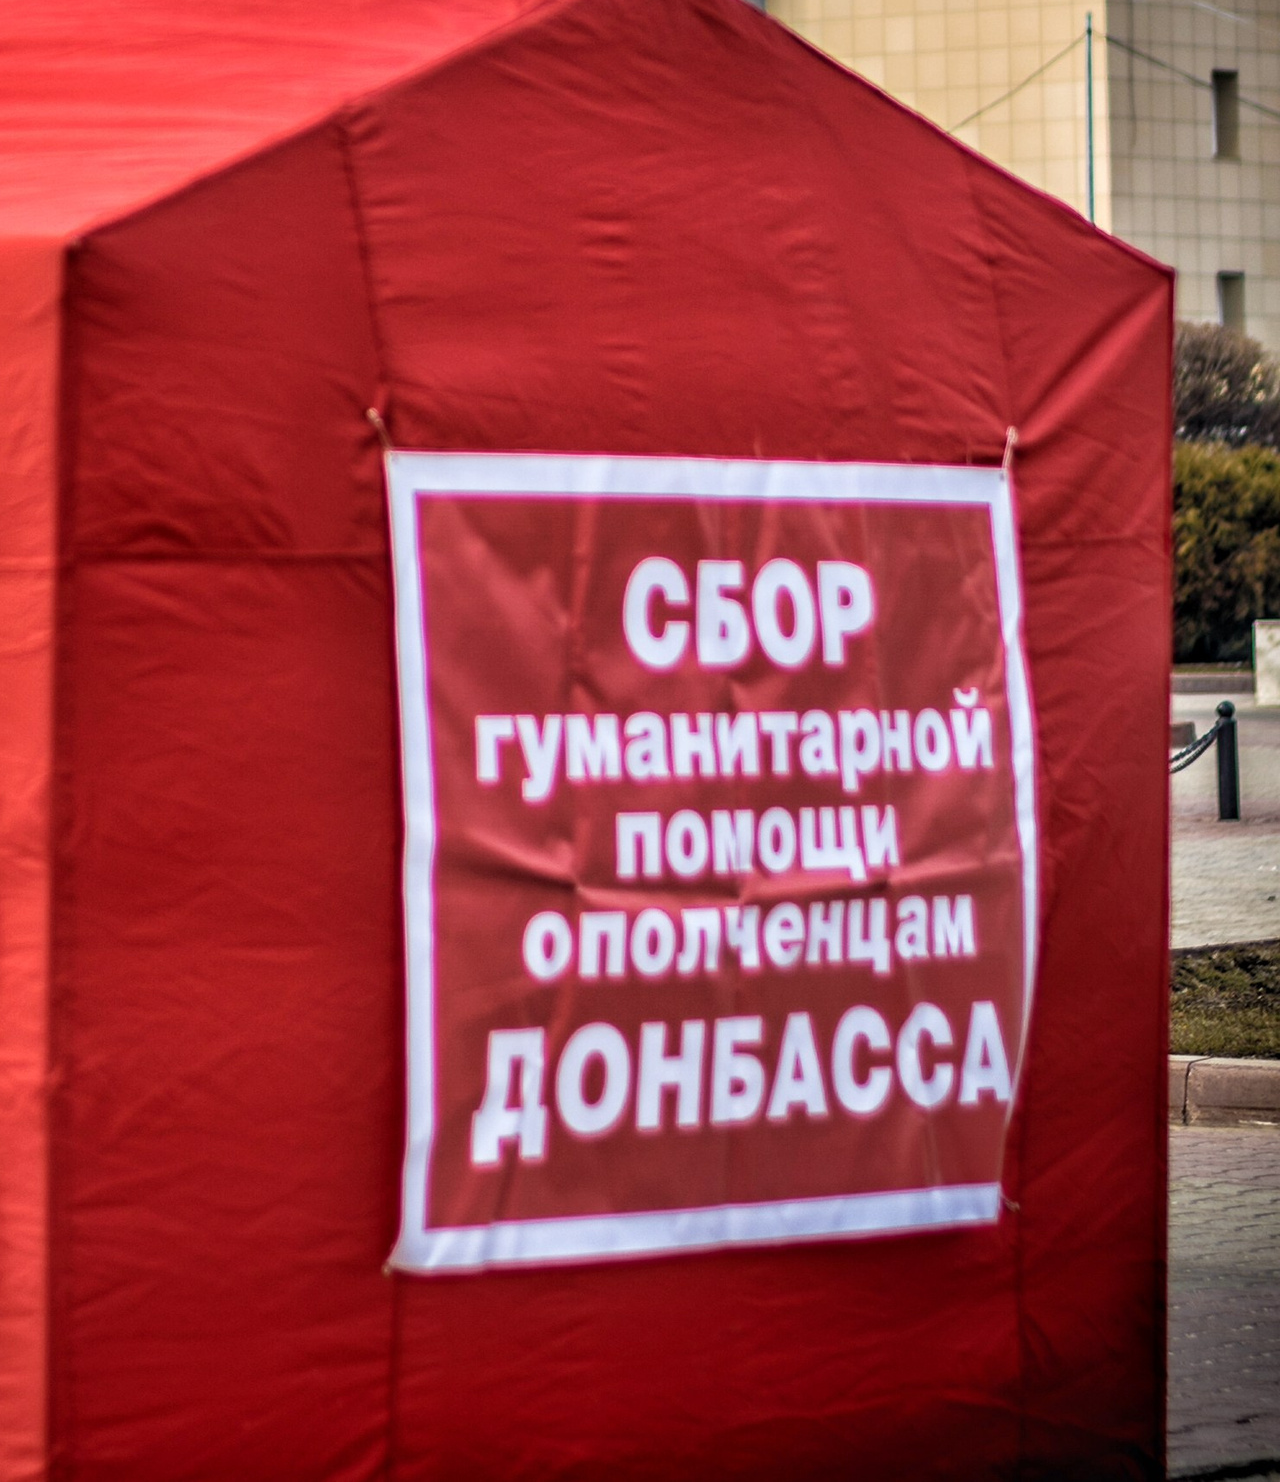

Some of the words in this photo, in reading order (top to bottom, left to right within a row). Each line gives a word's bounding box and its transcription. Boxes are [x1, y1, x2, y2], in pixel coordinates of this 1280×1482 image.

[623, 556, 874, 668] СБОР
[474, 686, 994, 802] гуманитарной
[616, 804, 900, 882] помощи
[522, 895, 976, 980] ополченцам
[471, 1001, 1012, 1166] ДОНБАССА
